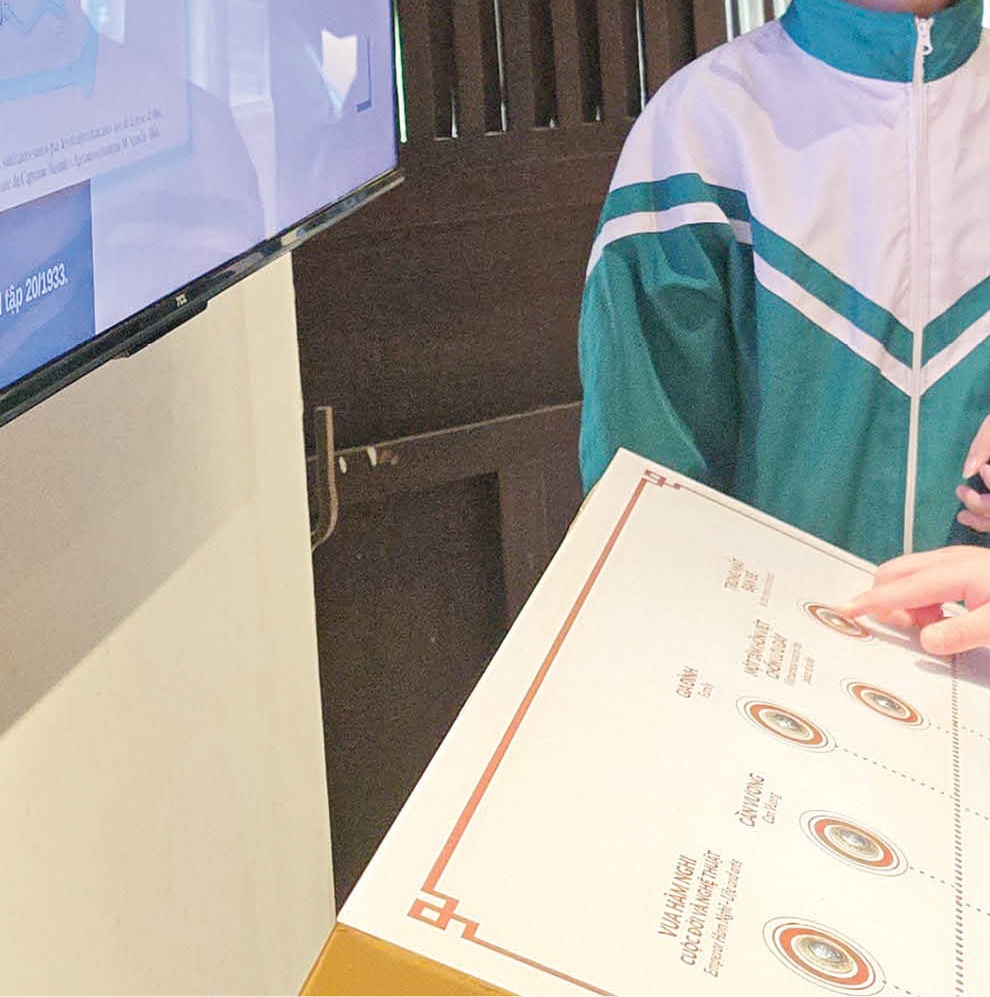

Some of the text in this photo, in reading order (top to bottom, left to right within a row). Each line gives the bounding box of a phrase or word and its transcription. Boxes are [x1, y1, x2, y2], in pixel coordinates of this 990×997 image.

[5, 262, 69, 314] tập 20/1933.
[658, 855, 697, 937] VUA HÀM NGHI
[680, 935, 702, 966] CUỘC
[697, 876, 718, 904] NGHỆ
